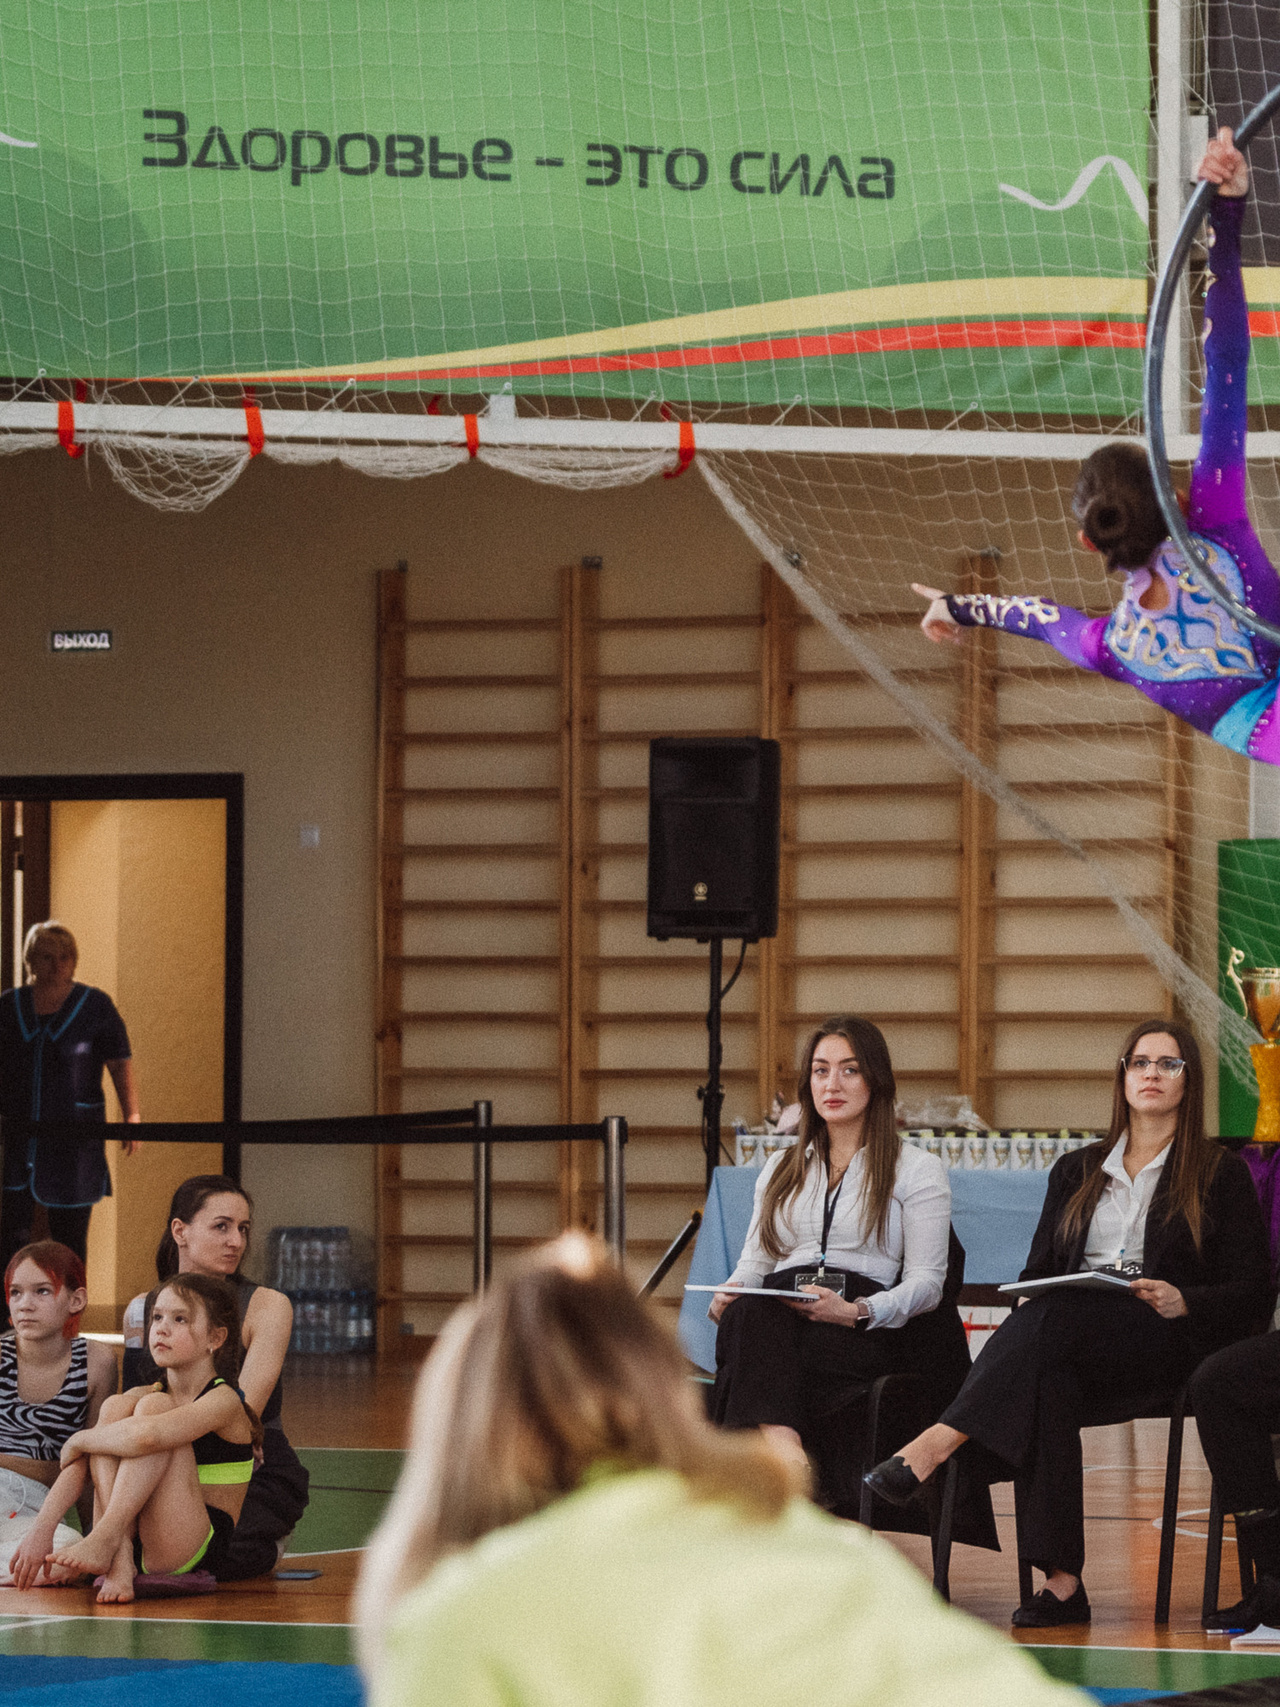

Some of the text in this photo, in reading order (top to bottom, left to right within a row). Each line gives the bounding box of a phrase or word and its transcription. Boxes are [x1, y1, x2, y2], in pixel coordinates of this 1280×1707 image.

[142, 109, 514, 186] Здоровье
[586, 143, 709, 191] это
[730, 151, 896, 200] сила
[54, 632, 110, 649] ВЫХОД
